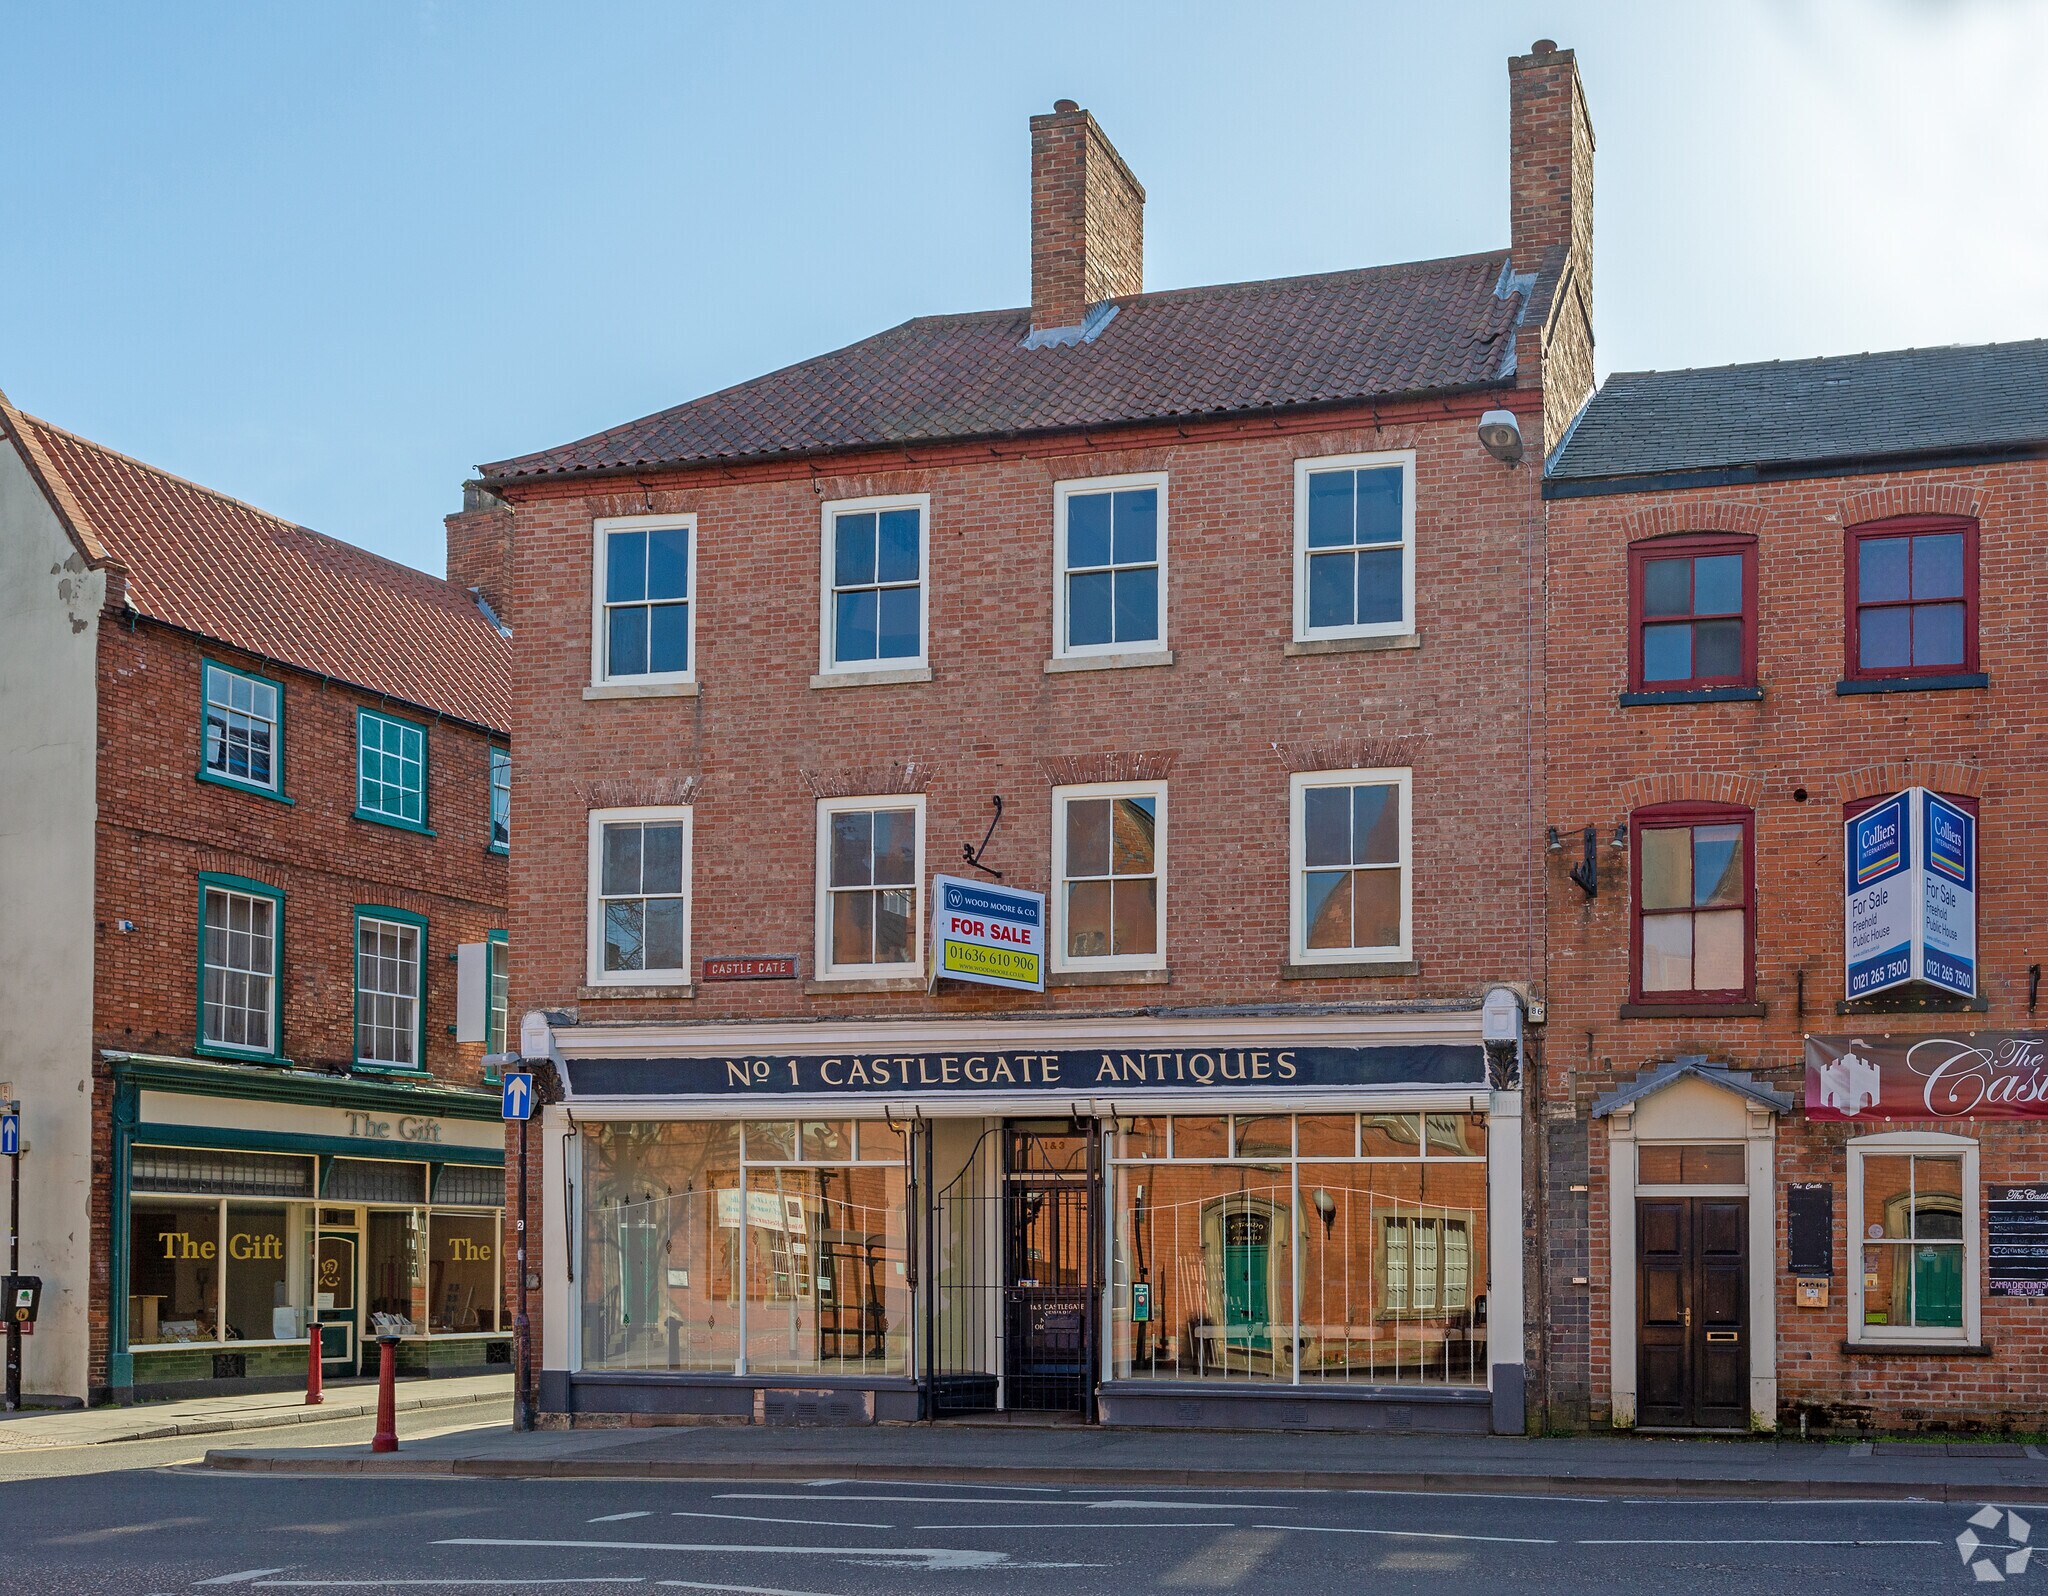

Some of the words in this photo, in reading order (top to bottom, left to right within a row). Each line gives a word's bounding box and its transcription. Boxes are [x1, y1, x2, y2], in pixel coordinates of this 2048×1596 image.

[1862, 822, 1895, 849] Colliers
[1934, 816, 1961, 847] Colliers
[1862, 838, 1895, 858] INTERNATIONAL
[1934, 836, 1961, 856] INTERNATIONAL
[1852, 897, 1867, 918] For
[1868, 887, 1888, 910] Sale
[1926, 877, 1939, 899] For
[1940, 887, 1956, 908] Sale
[964, 897, 989, 908] WOOD
[990, 902, 1016, 913] MOORE
[1017, 906, 1023, 915] &
[1024, 908, 1036, 917] CO.
[1926, 900, 1948, 921] Freehold
[951, 917, 985, 938] FOR
[990, 923, 1031, 945] SALE
[1852, 912, 1877, 934] Freehold
[1926, 916, 1942, 935] Public
[1942, 924, 1958, 941] House
[1852, 931, 1870, 949] Public
[1870, 925, 1890, 943] House
[712, 963, 752, 974] CASTLE
[950, 945, 986, 963] 01636
[989, 953, 1010, 967] 610
[1013, 955, 1034, 970] 906
[1853, 972, 1868, 991] 0121
[1870, 966, 1885, 984] 265
[1887, 958, 1908, 979] 7500
[1926, 958, 1940, 978] 0121
[1941, 964, 1953, 982] 265
[1955, 968, 1971, 989] 7500
[1994, 1038, 2044, 1068] The
[787, 1059, 800, 1086] 1
[820, 1055, 1062, 1086] CASTLEGATE
[1096, 1052, 1297, 1085] ANTIQUES
[345, 1111, 391, 1138] The
[399, 1116, 442, 1142] Gift
[2006, 1188, 2025, 1200] The
[517, 1220, 523, 1230] 2
[158, 1232, 216, 1259] The
[229, 1233, 284, 1260] Gift
[448, 1238, 491, 1261] The
[1990, 1281, 2012, 1289] CAMRA
